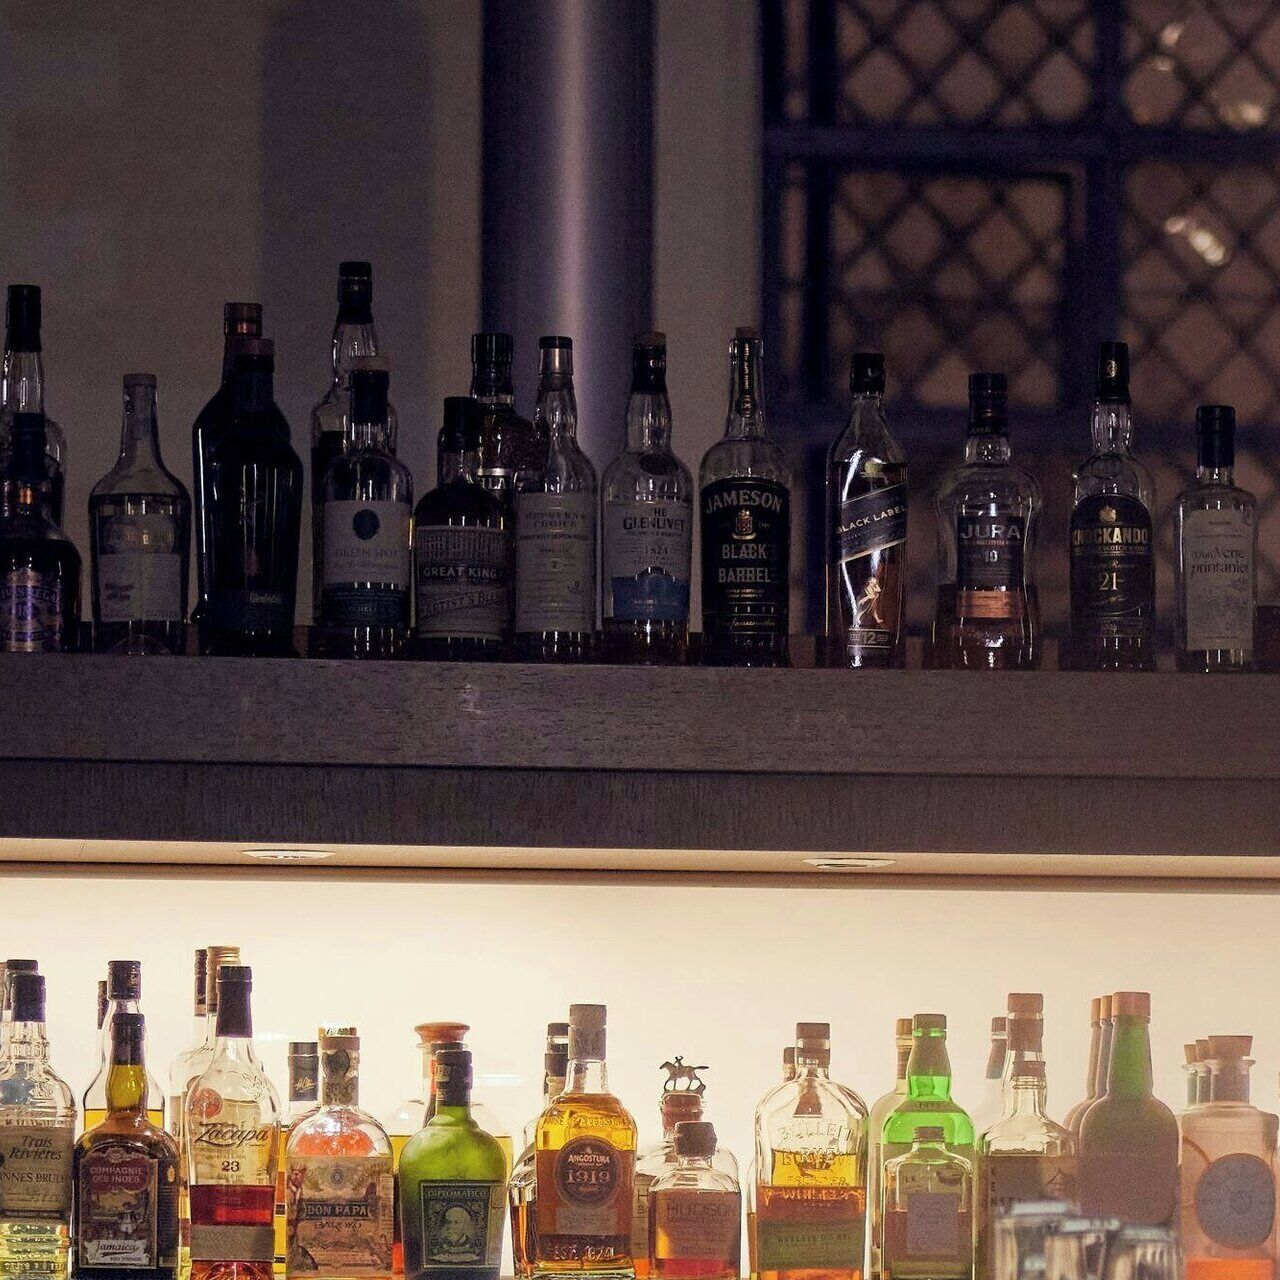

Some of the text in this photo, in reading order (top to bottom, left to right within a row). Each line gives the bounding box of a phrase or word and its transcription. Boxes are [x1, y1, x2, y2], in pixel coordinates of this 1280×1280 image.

[705, 489, 783, 514] JAMESON
[622, 517, 686, 532] GLENLIVET
[960, 523, 1021, 539] JURA
[721, 543, 768, 559] BLACK
[422, 566, 498, 580] GREAT KING
[717, 566, 771, 583] BARREL
[1099, 572, 1119, 591] 21
[193, 1120, 271, 1149] Zacapa
[221, 1160, 240, 1173] 23
[567, 1154, 611, 1164] ANGOSTURA
[566, 1169, 611, 1185] 1919
[307, 1205, 369, 1216] DON PAPA
